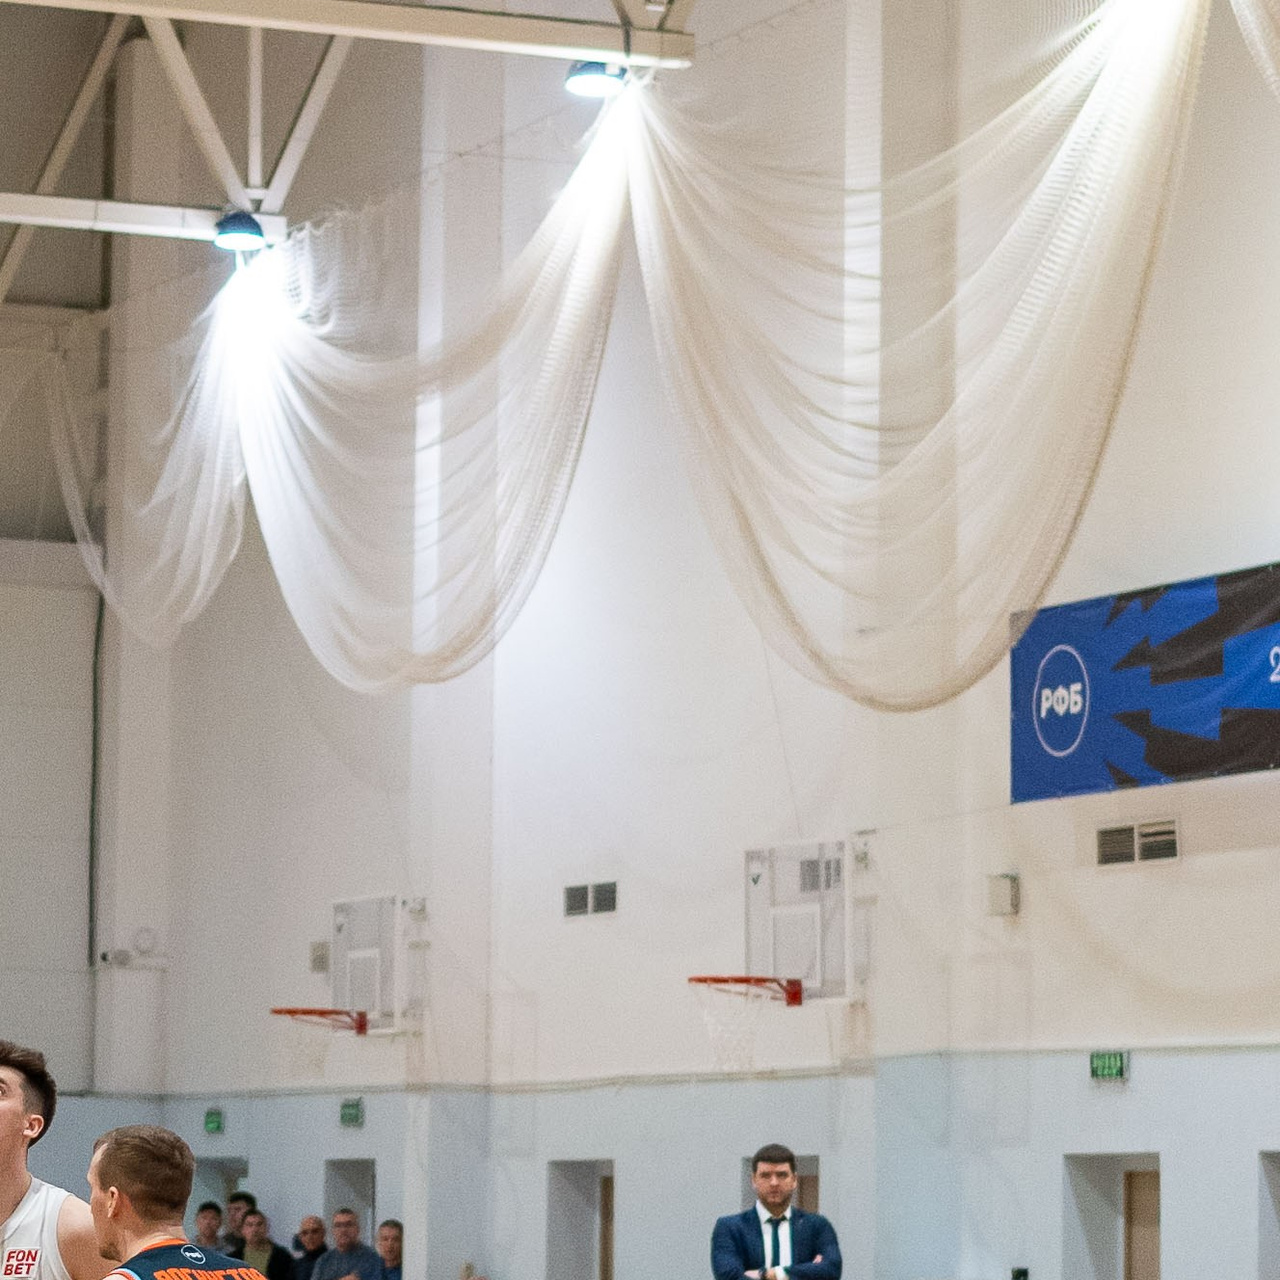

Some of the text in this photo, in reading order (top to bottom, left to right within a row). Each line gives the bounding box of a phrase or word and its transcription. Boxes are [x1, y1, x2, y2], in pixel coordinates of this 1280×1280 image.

[1039, 681, 1083, 719] РФБ
[6, 1249, 39, 1263] FON
[3, 1262, 36, 1276] BET
